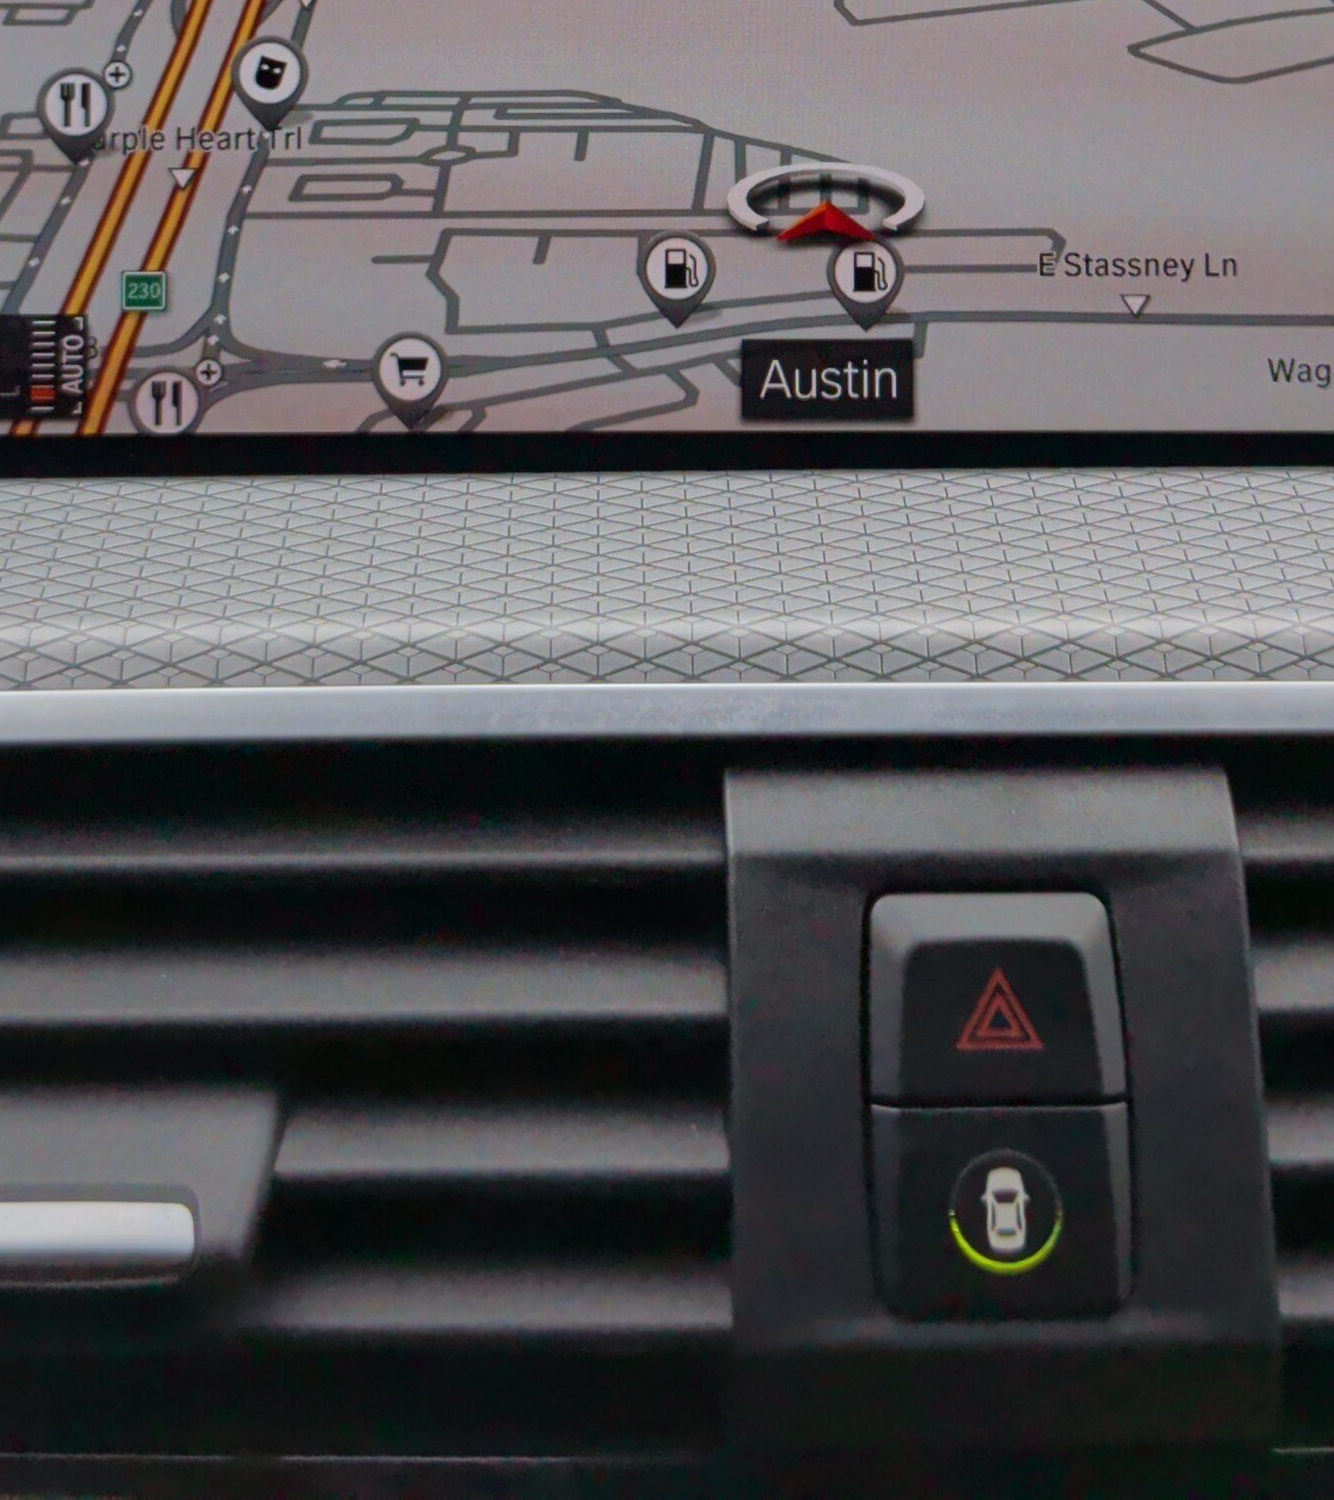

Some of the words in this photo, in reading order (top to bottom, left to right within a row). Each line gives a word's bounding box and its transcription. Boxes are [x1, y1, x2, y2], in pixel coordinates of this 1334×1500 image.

[176, 126, 255, 151] Heart
[269, 126, 302, 151] Trl
[1039, 252, 1056, 277] E
[1065, 252, 1196, 283] Stassney
[1204, 252, 1238, 278] Ln
[127, 282, 162, 300] 230
[60, 334, 85, 396] AUTO
[759, 358, 898, 399] Austin
